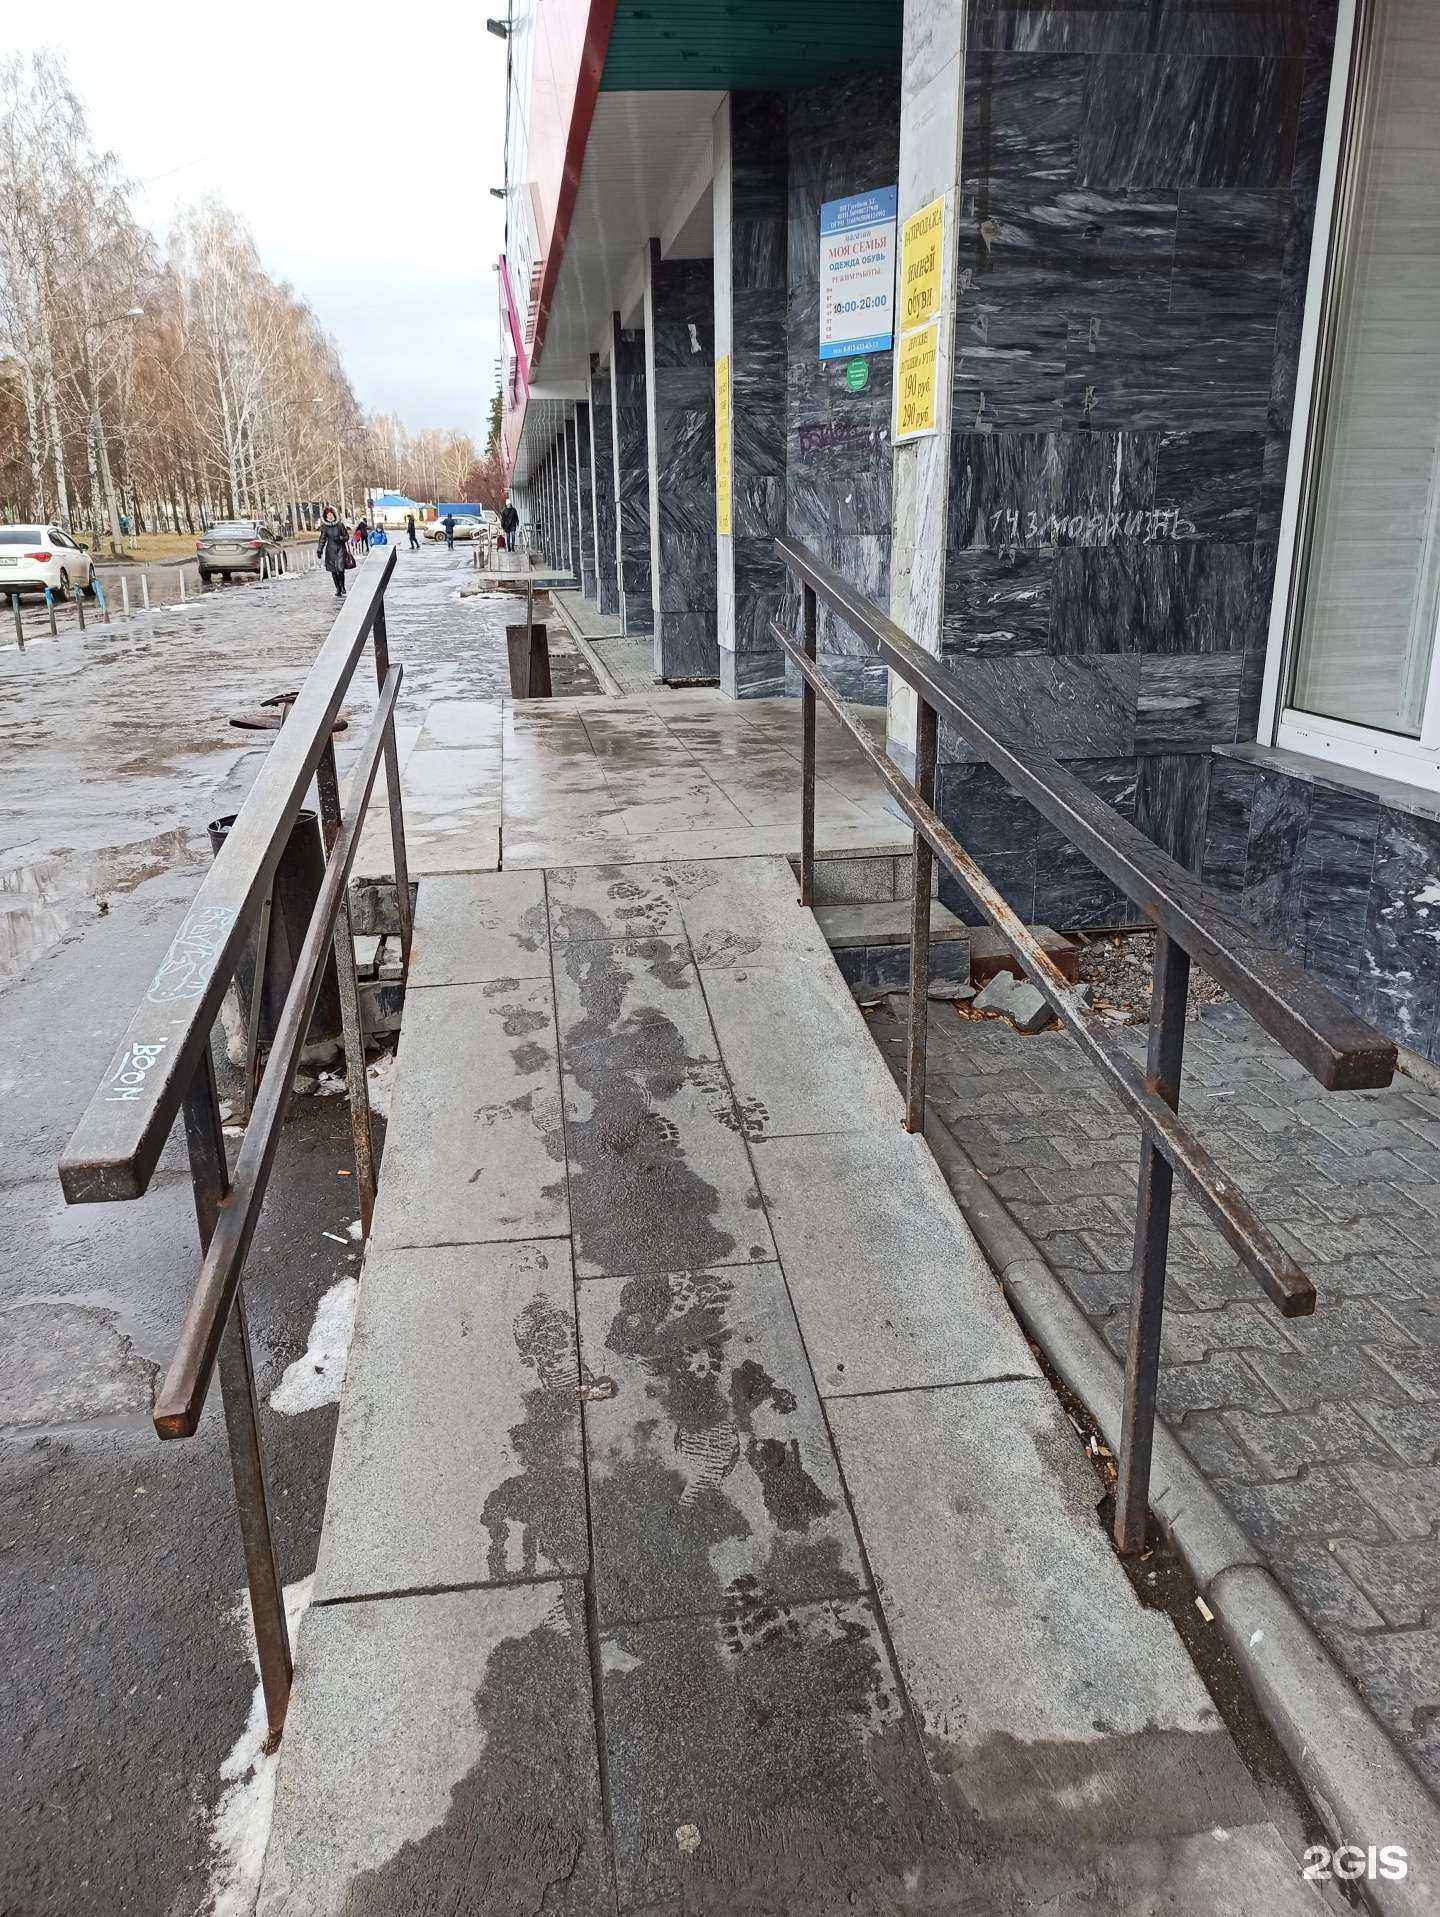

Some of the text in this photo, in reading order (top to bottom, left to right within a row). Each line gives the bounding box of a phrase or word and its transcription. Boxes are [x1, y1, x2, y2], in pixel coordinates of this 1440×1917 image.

[829, 237, 887, 260] МОЯ СЕМЬЯ
[829, 252, 886, 273] ОДЕЖДА ОБУВЬ
[833, 295, 887, 313] 10:00-20:00
[904, 373, 917, 399] 190
[902, 402, 916, 427] 290
